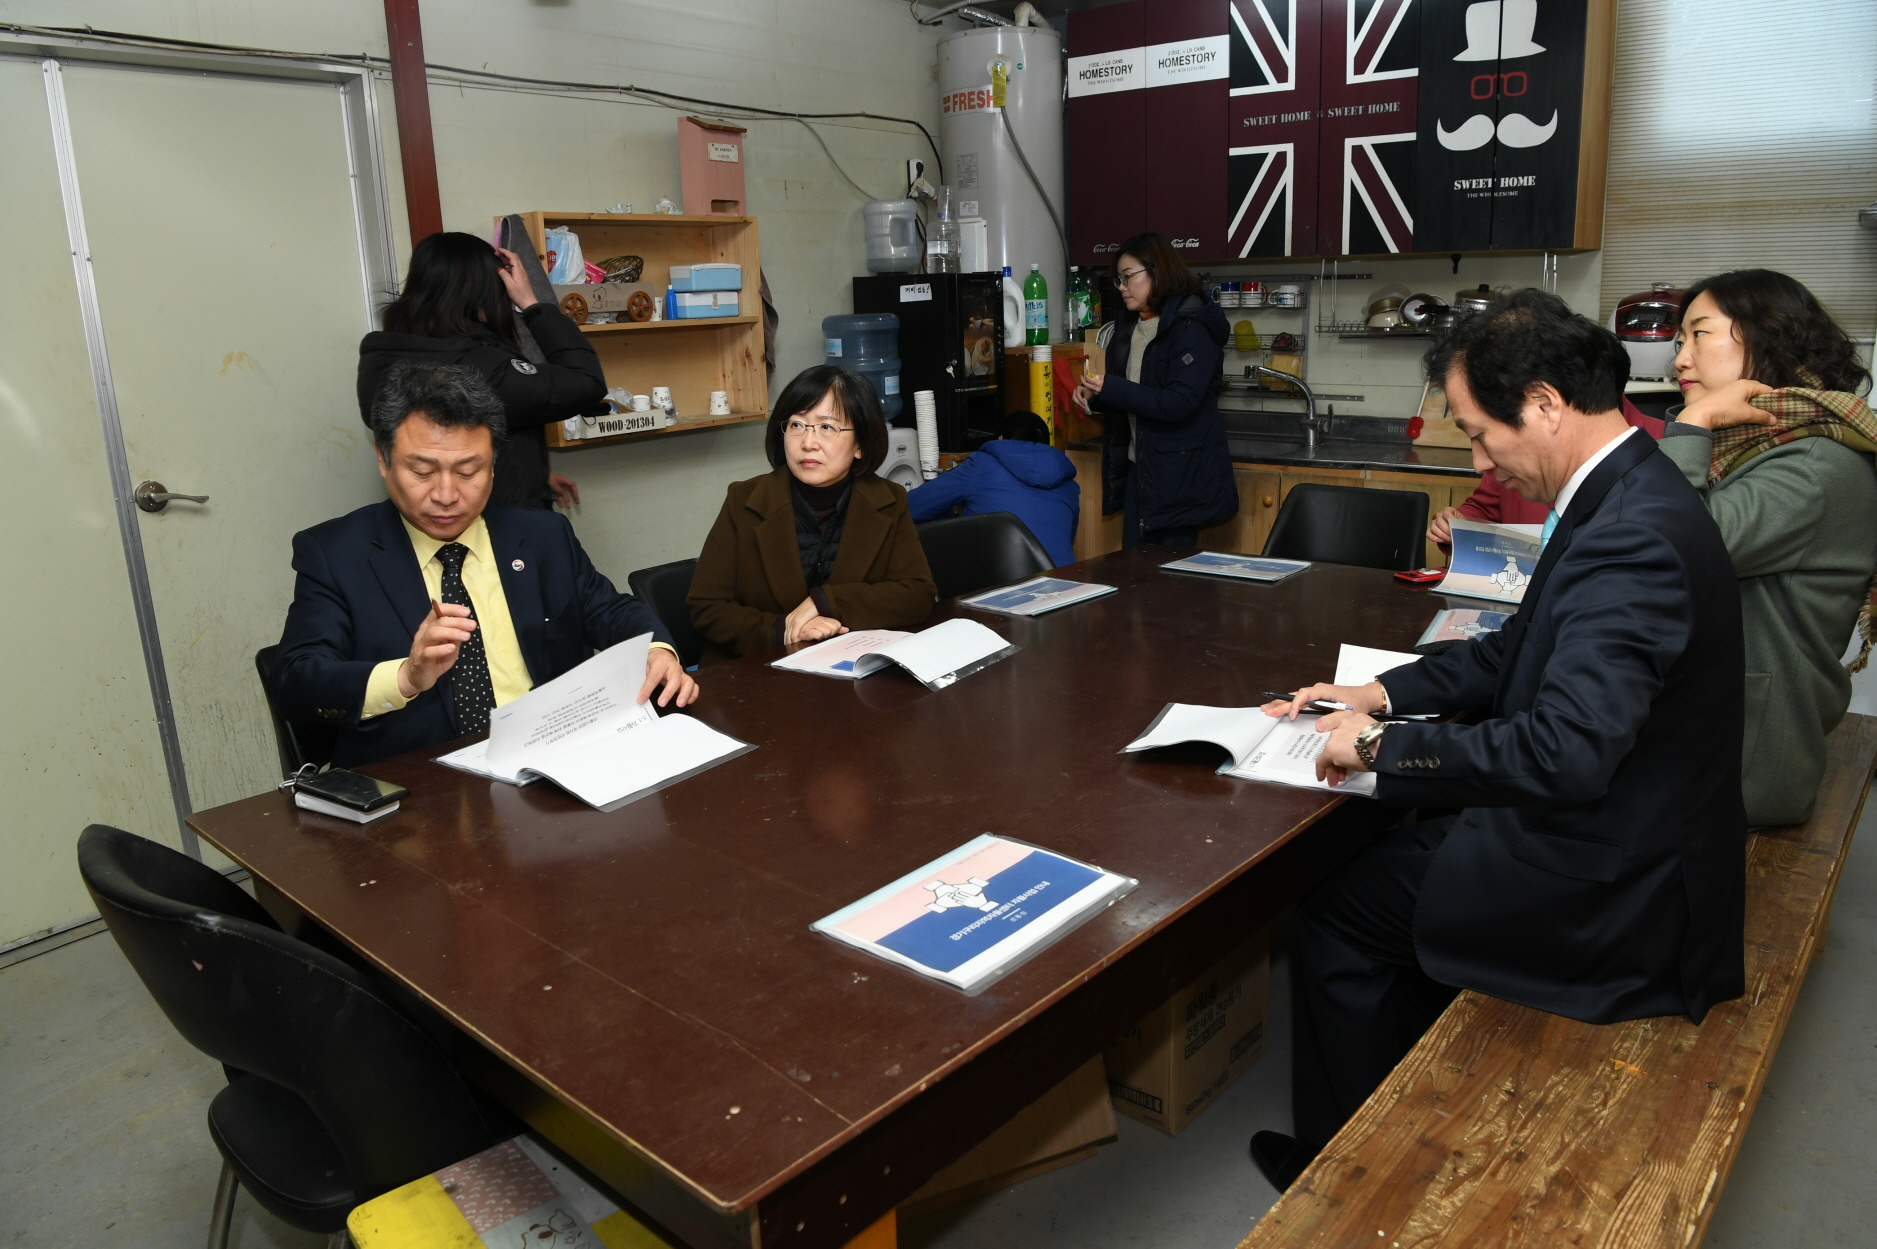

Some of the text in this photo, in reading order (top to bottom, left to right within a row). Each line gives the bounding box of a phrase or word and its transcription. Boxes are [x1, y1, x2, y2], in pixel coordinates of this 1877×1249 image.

[1158, 51, 1217, 69] HOMESTORY
[1079, 64, 1134, 81] HOMESTORY
[1243, 115, 1278, 127] SWEET
[1280, 111, 1311, 123] HOME
[1327, 105, 1364, 118] SWEET
[1367, 102, 1400, 114] HOME
[1453, 175, 1536, 190] SWEET HOME
[1185, 238, 1200, 248] Coca
[1035, 880, 1051, 892] 안내
